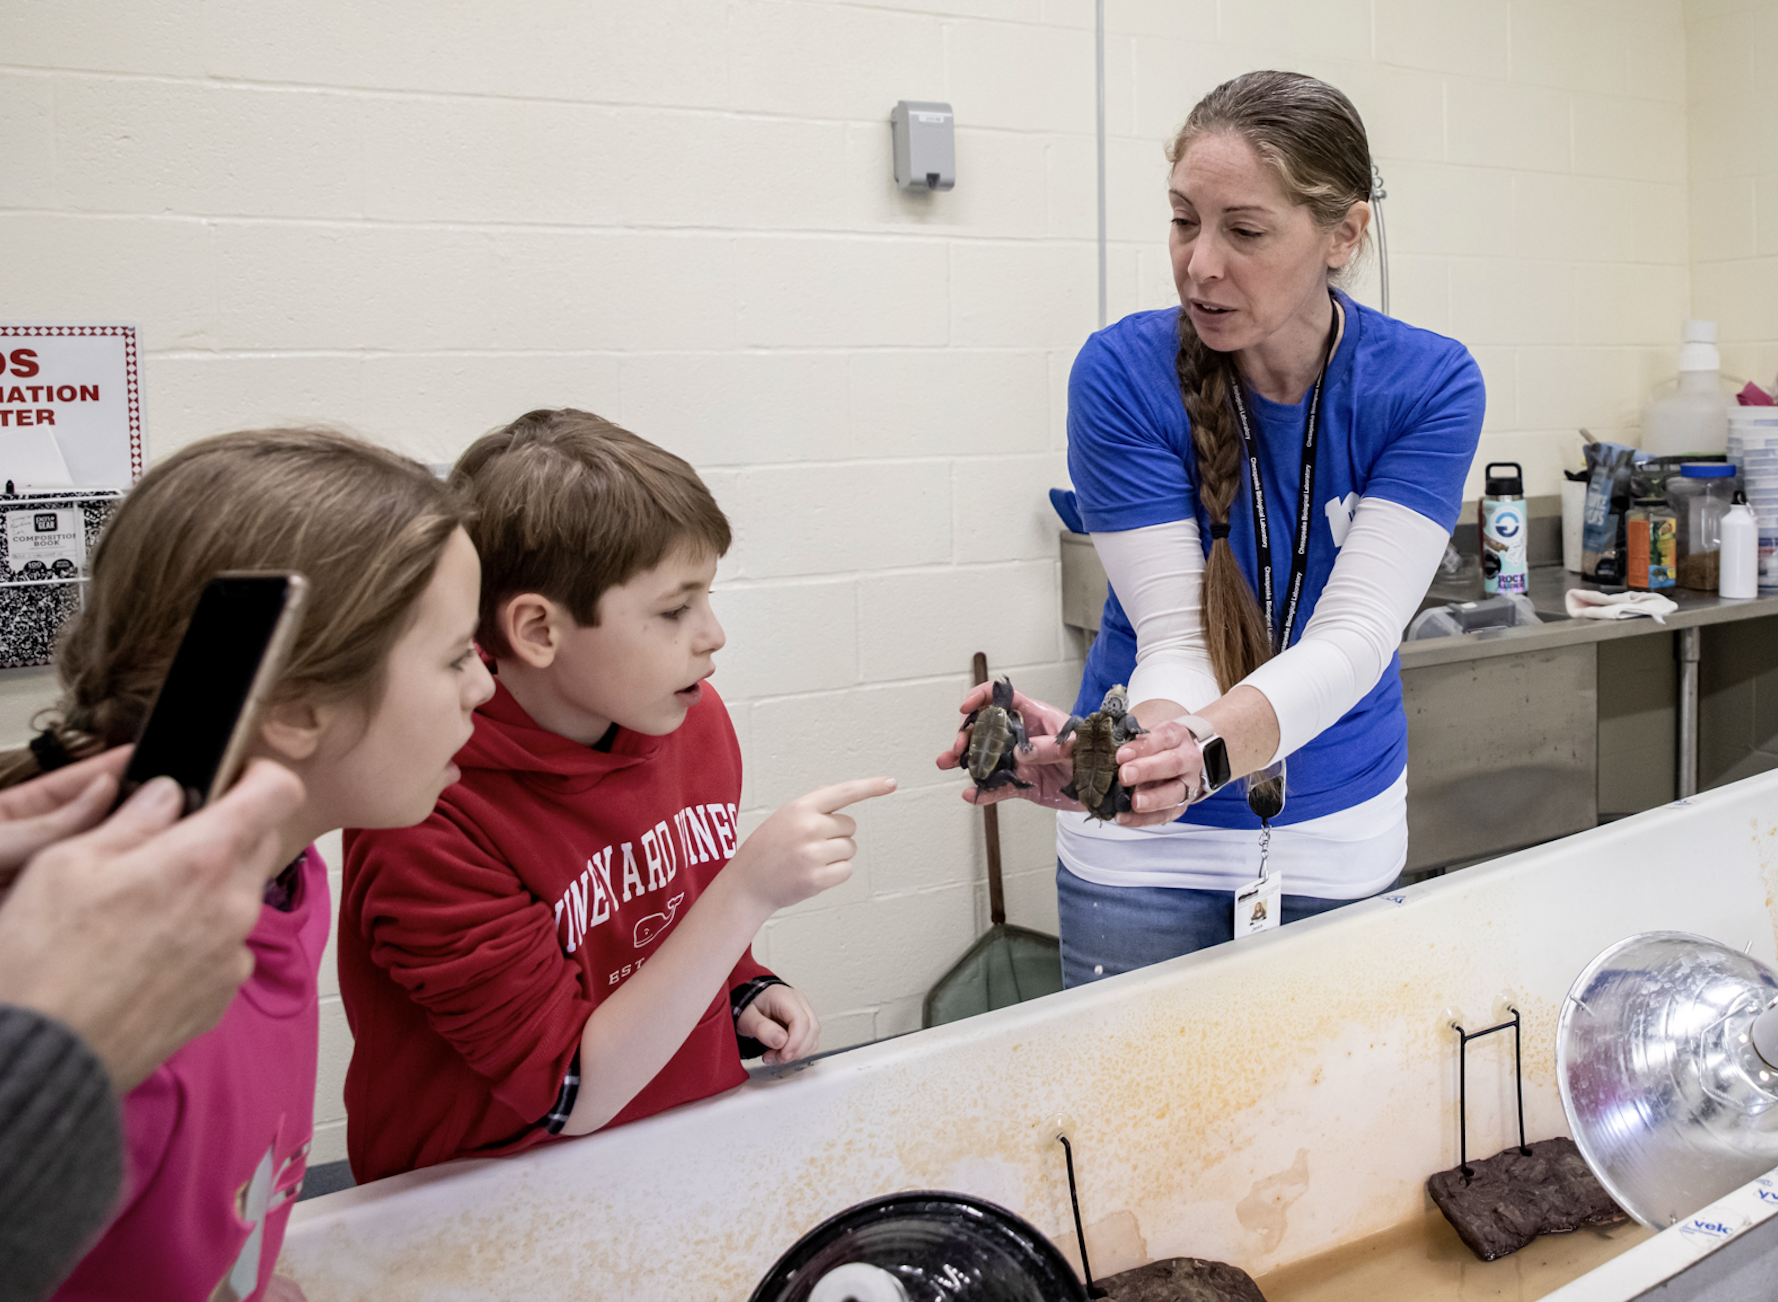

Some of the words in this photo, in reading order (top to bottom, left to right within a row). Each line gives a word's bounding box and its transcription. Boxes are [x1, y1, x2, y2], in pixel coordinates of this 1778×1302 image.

[0, 348, 40, 378] S
[0, 384, 100, 403] ATION
[1251, 457, 1260, 490] Chesapeake
[1303, 464, 1311, 494] Laboratory
[1256, 490, 1265, 517] Biological
[1301, 494, 1310, 521] Biological
[1259, 518, 1268, 548] Laboratory
[1298, 521, 1308, 554] Chesapeake
[1264, 566, 1272, 600] Chesapeake
[1265, 600, 1273, 628] Biological
[1285, 601, 1296, 627] Biological
[1291, 572, 1302, 600] Laboratory
[608, 957, 646, 986] EST
